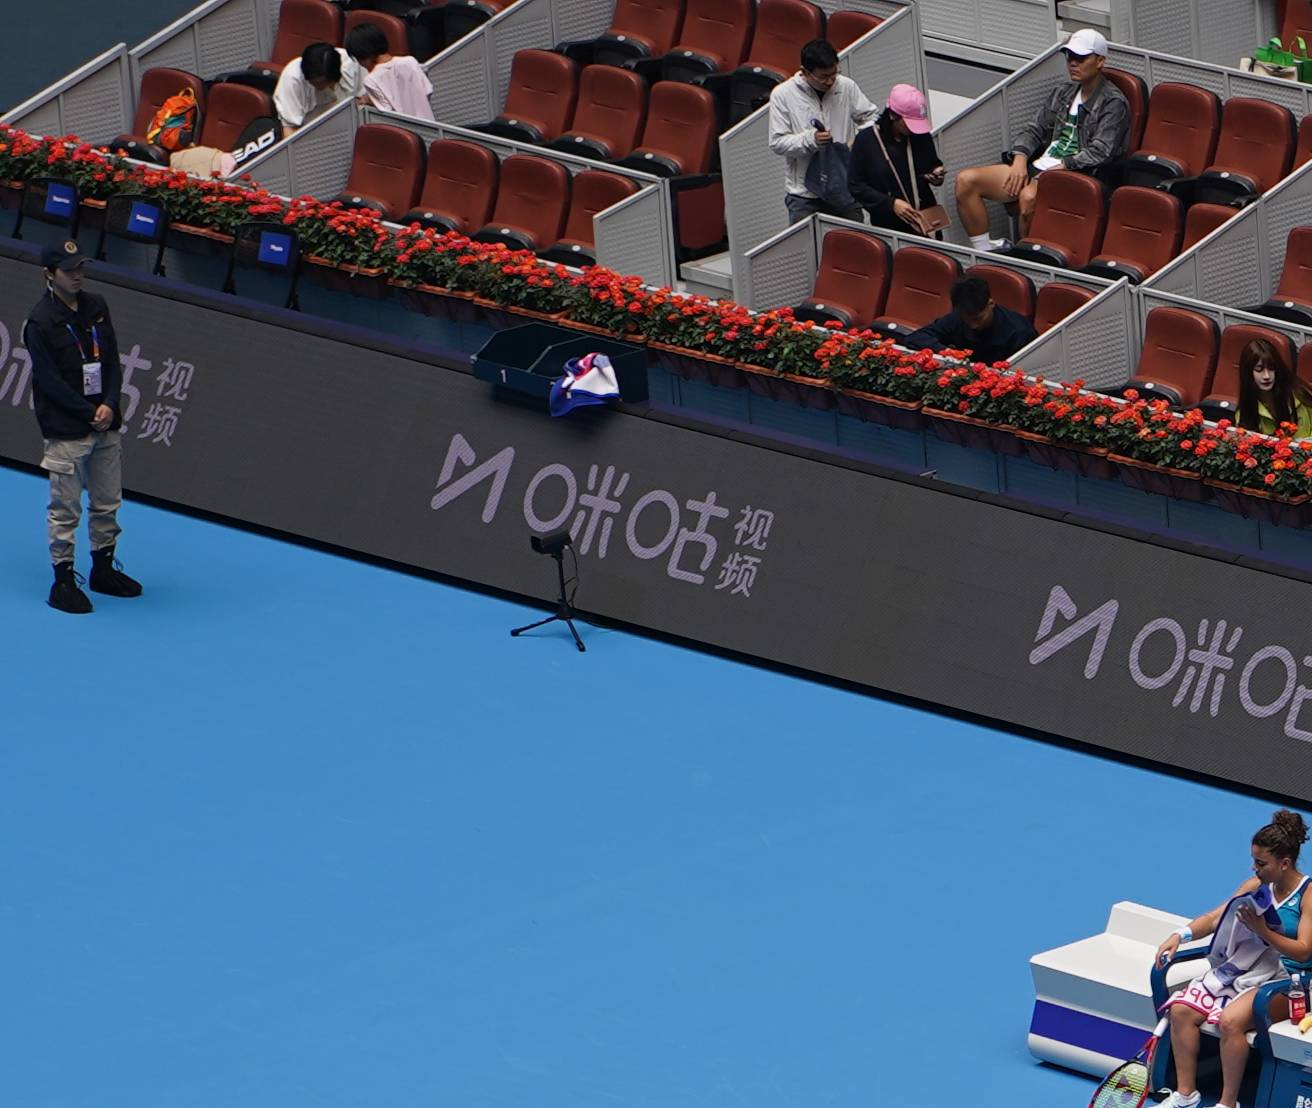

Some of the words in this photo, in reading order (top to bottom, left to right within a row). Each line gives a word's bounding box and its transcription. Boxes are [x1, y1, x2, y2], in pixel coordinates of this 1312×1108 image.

[232, 130, 275, 162] EAD
[137, 357, 195, 447] 视频
[500, 369, 506, 383] 1
[523, 463, 729, 585] 咪咕
[715, 505, 775, 597] 视频
